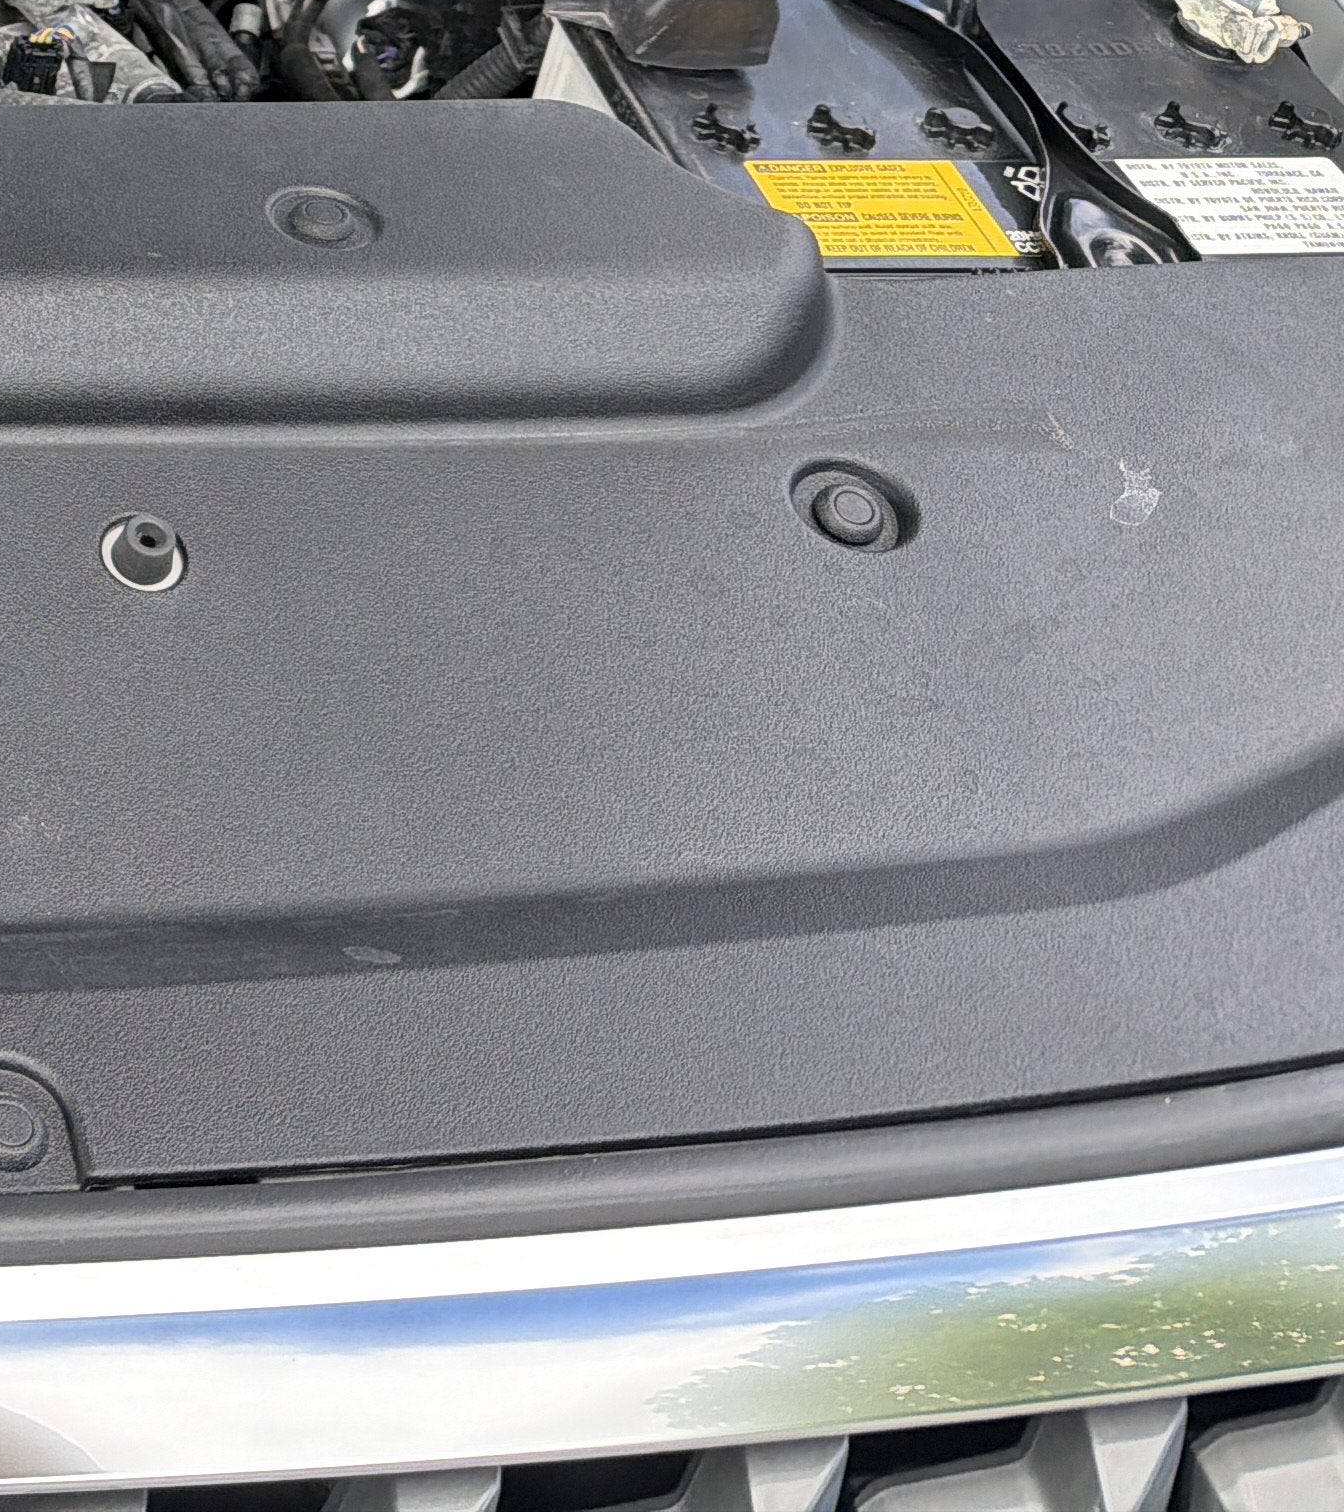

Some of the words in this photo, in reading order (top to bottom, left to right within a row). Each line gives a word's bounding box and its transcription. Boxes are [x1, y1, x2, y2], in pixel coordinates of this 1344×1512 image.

[770, 163, 824, 173] DANGER
[836, 201, 853, 209] TIP
[802, 212, 857, 222] POISON
[824, 244, 847, 253] KEEP
[851, 244, 869, 253] OUT
[884, 244, 913, 253] REACH
[930, 244, 976, 253] CHILDREN
